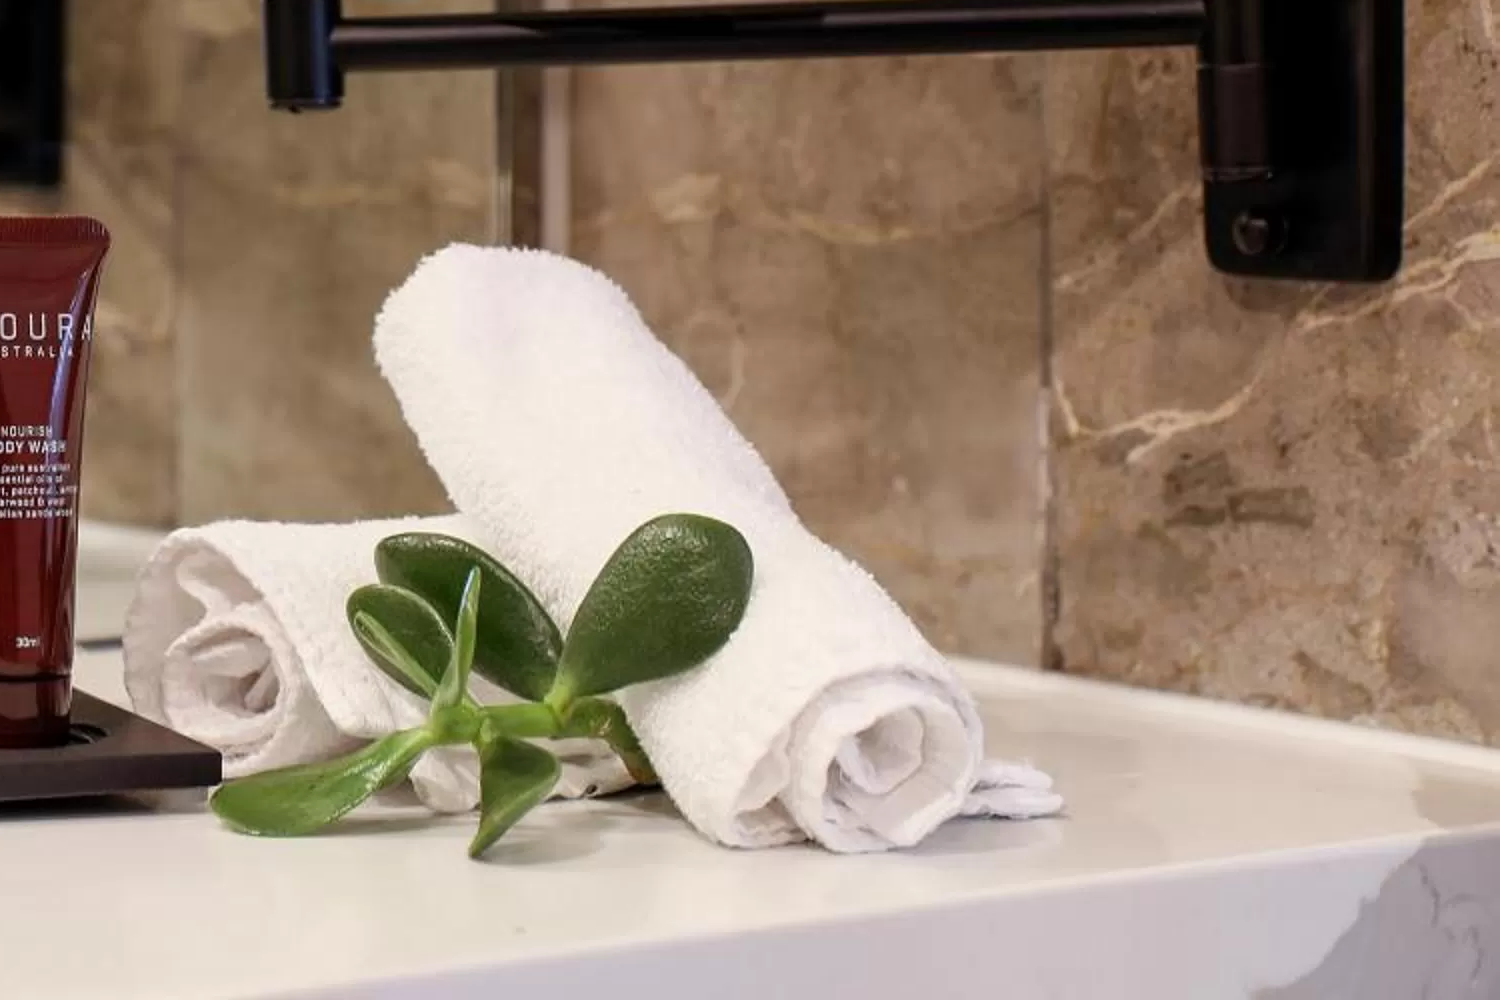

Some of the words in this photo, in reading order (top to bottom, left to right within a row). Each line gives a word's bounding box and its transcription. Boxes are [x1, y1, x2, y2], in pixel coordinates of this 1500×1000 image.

[1, 425, 53, 438] NOURISH
[28, 440, 66, 454] WASH
[1, 464, 25, 475] pure
[15, 635, 40, 648] 30ml
